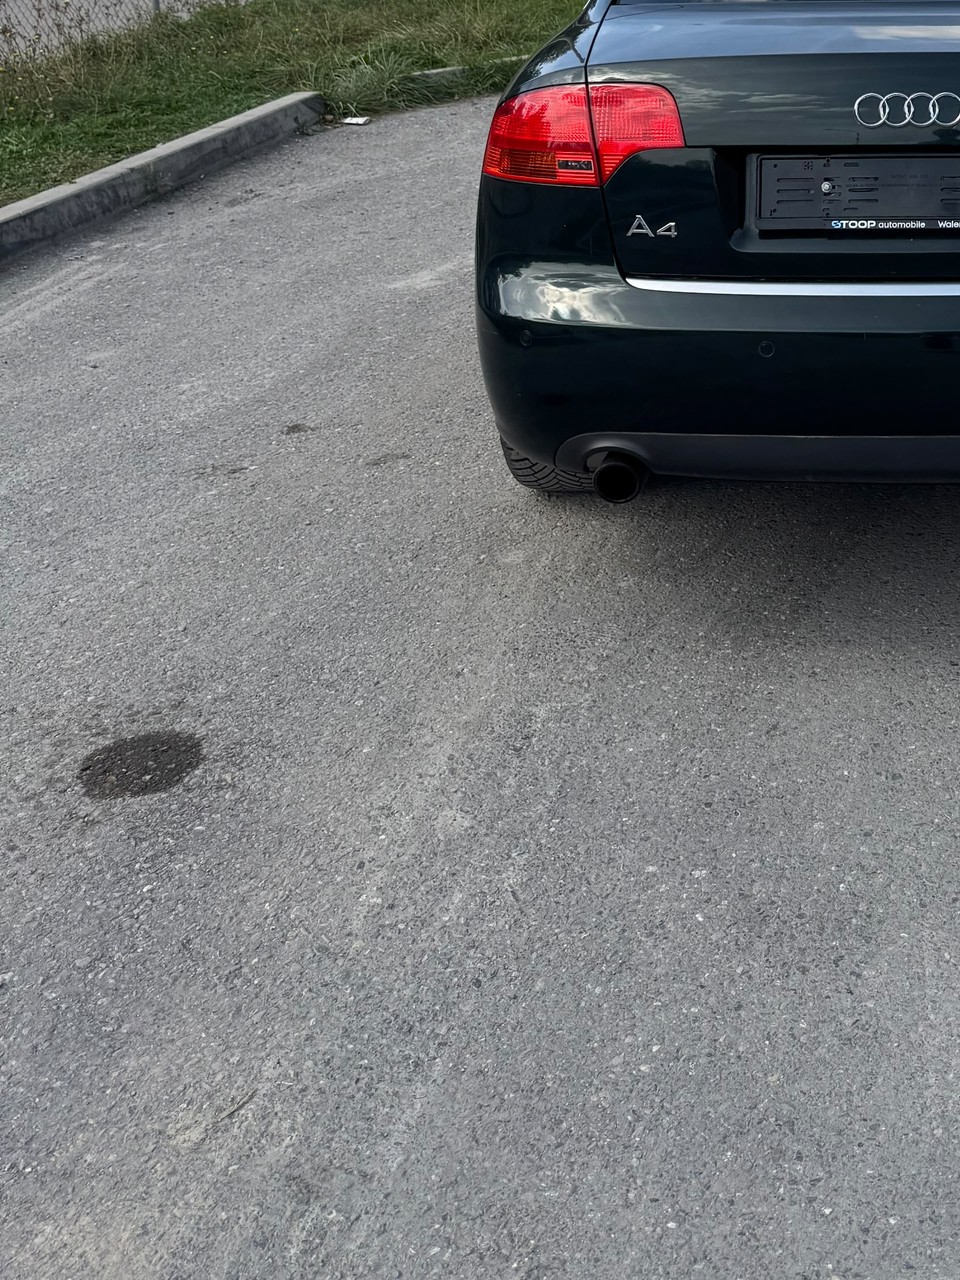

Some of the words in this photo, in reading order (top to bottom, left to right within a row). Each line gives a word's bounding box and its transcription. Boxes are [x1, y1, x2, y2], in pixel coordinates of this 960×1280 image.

[626, 214, 678, 238] A4
[831, 220, 876, 229] STOOP
[878, 220, 926, 229] automobile
